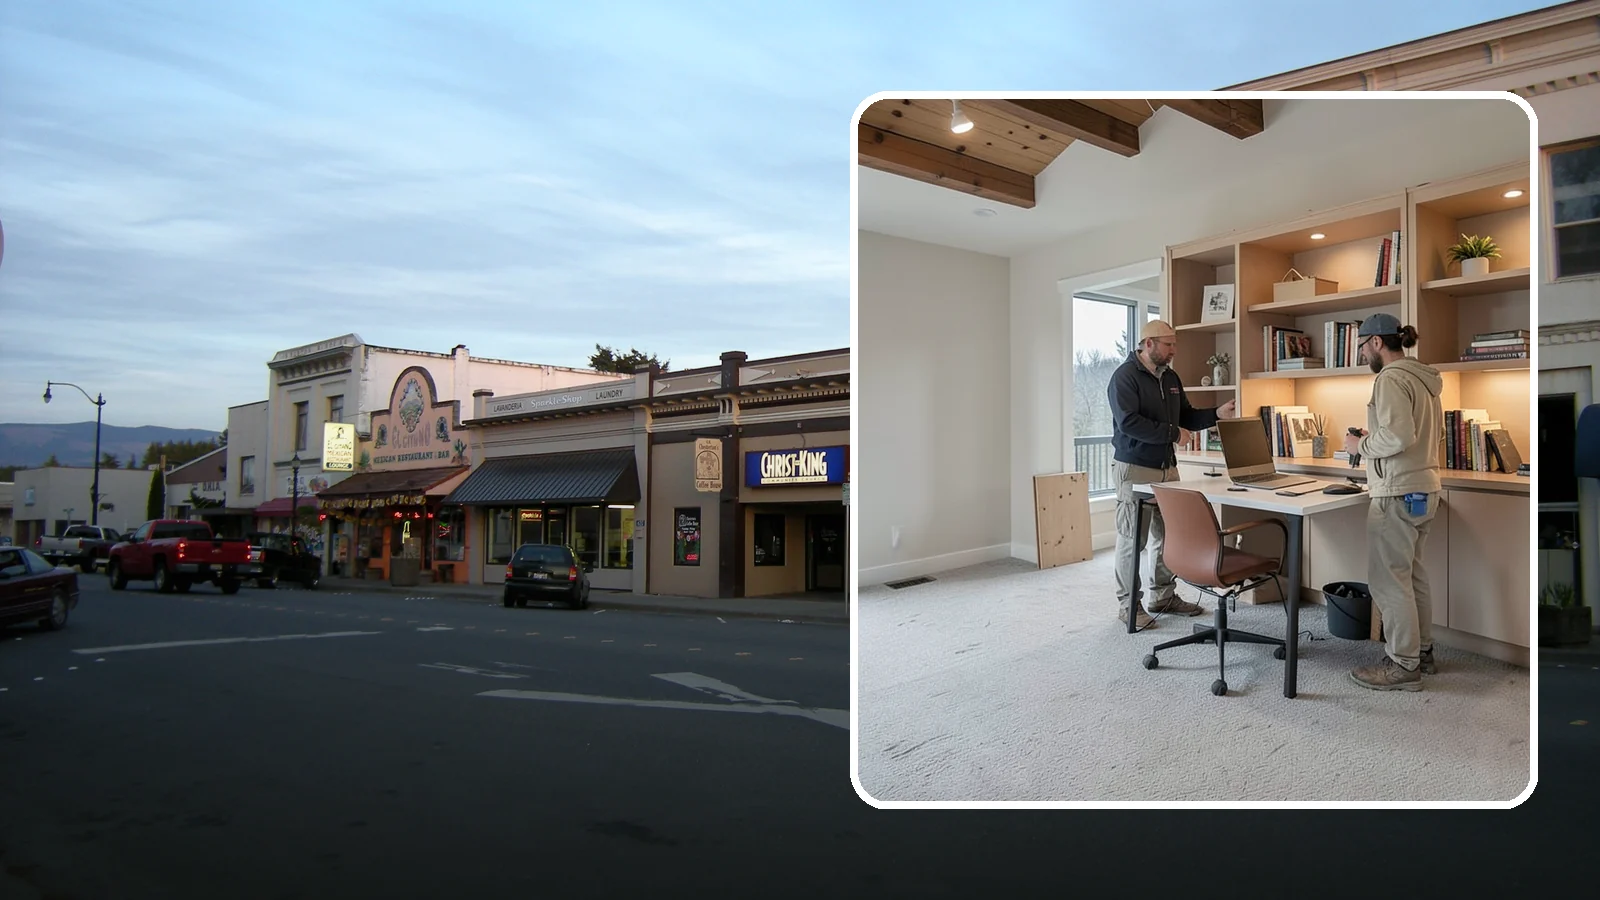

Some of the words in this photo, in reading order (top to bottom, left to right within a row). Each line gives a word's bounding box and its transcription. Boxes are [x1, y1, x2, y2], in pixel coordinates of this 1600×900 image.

[493, 402, 523, 412] LAVANDERIA
[560, 394, 582, 405] Shop
[595, 389, 623, 400] LAUNDRY
[374, 455, 396, 464] MEXICAN
[398, 451, 433, 462] RESTAURANT
[438, 450, 450, 459] BAR
[761, 451, 797, 478] CHRIST
[799, 450, 828, 476] KING
